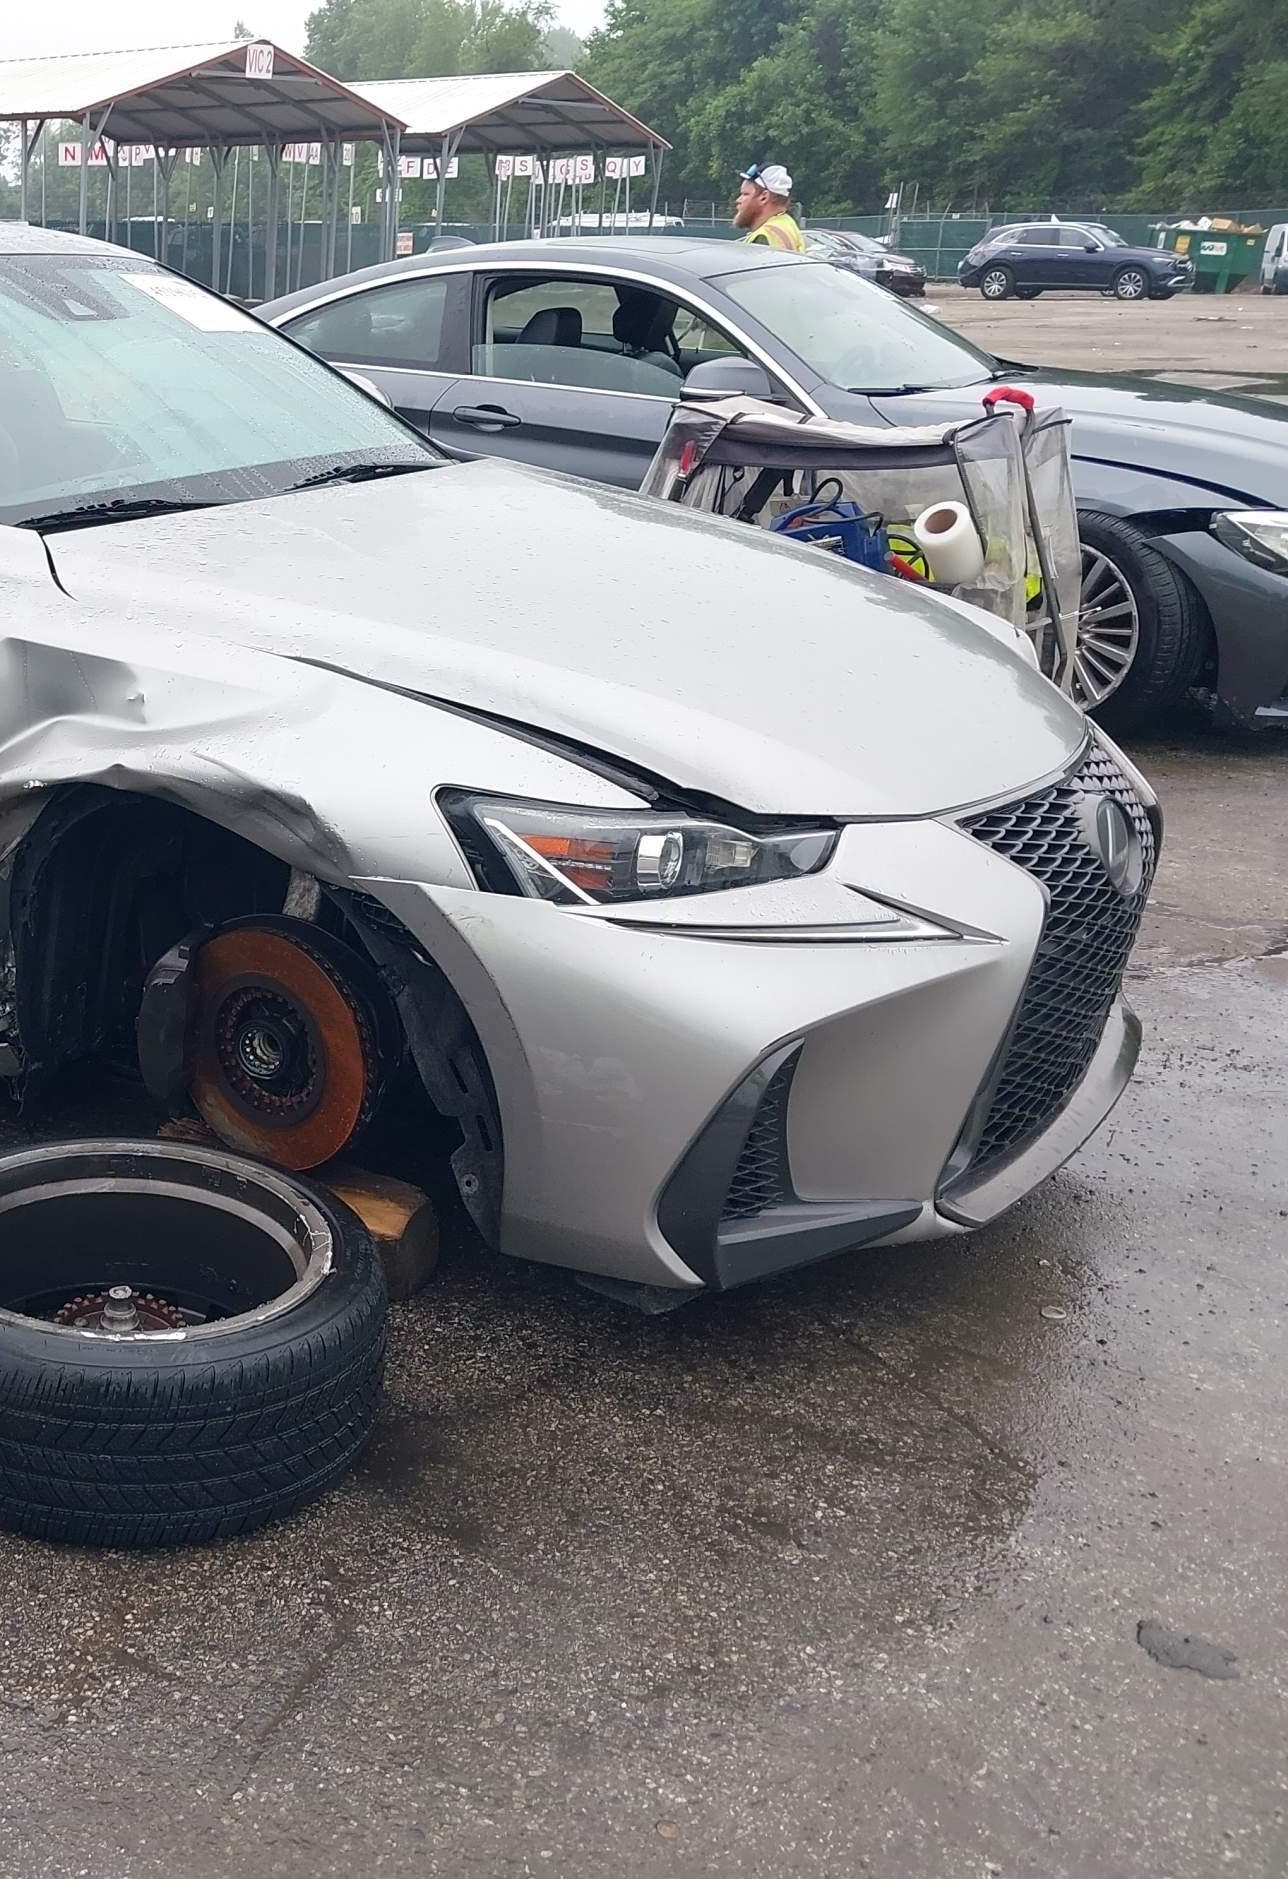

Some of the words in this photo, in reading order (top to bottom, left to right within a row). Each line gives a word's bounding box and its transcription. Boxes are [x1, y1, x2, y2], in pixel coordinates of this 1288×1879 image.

[249, 49, 264, 72] VIC
[266, 50, 272, 73] 2
[64, 146, 76, 161] N
[407, 161, 415, 173] F
[519, 160, 528, 172] S
[580, 159, 588, 171] S
[607, 161, 617, 174] Q
[633, 160, 642, 173] Y
